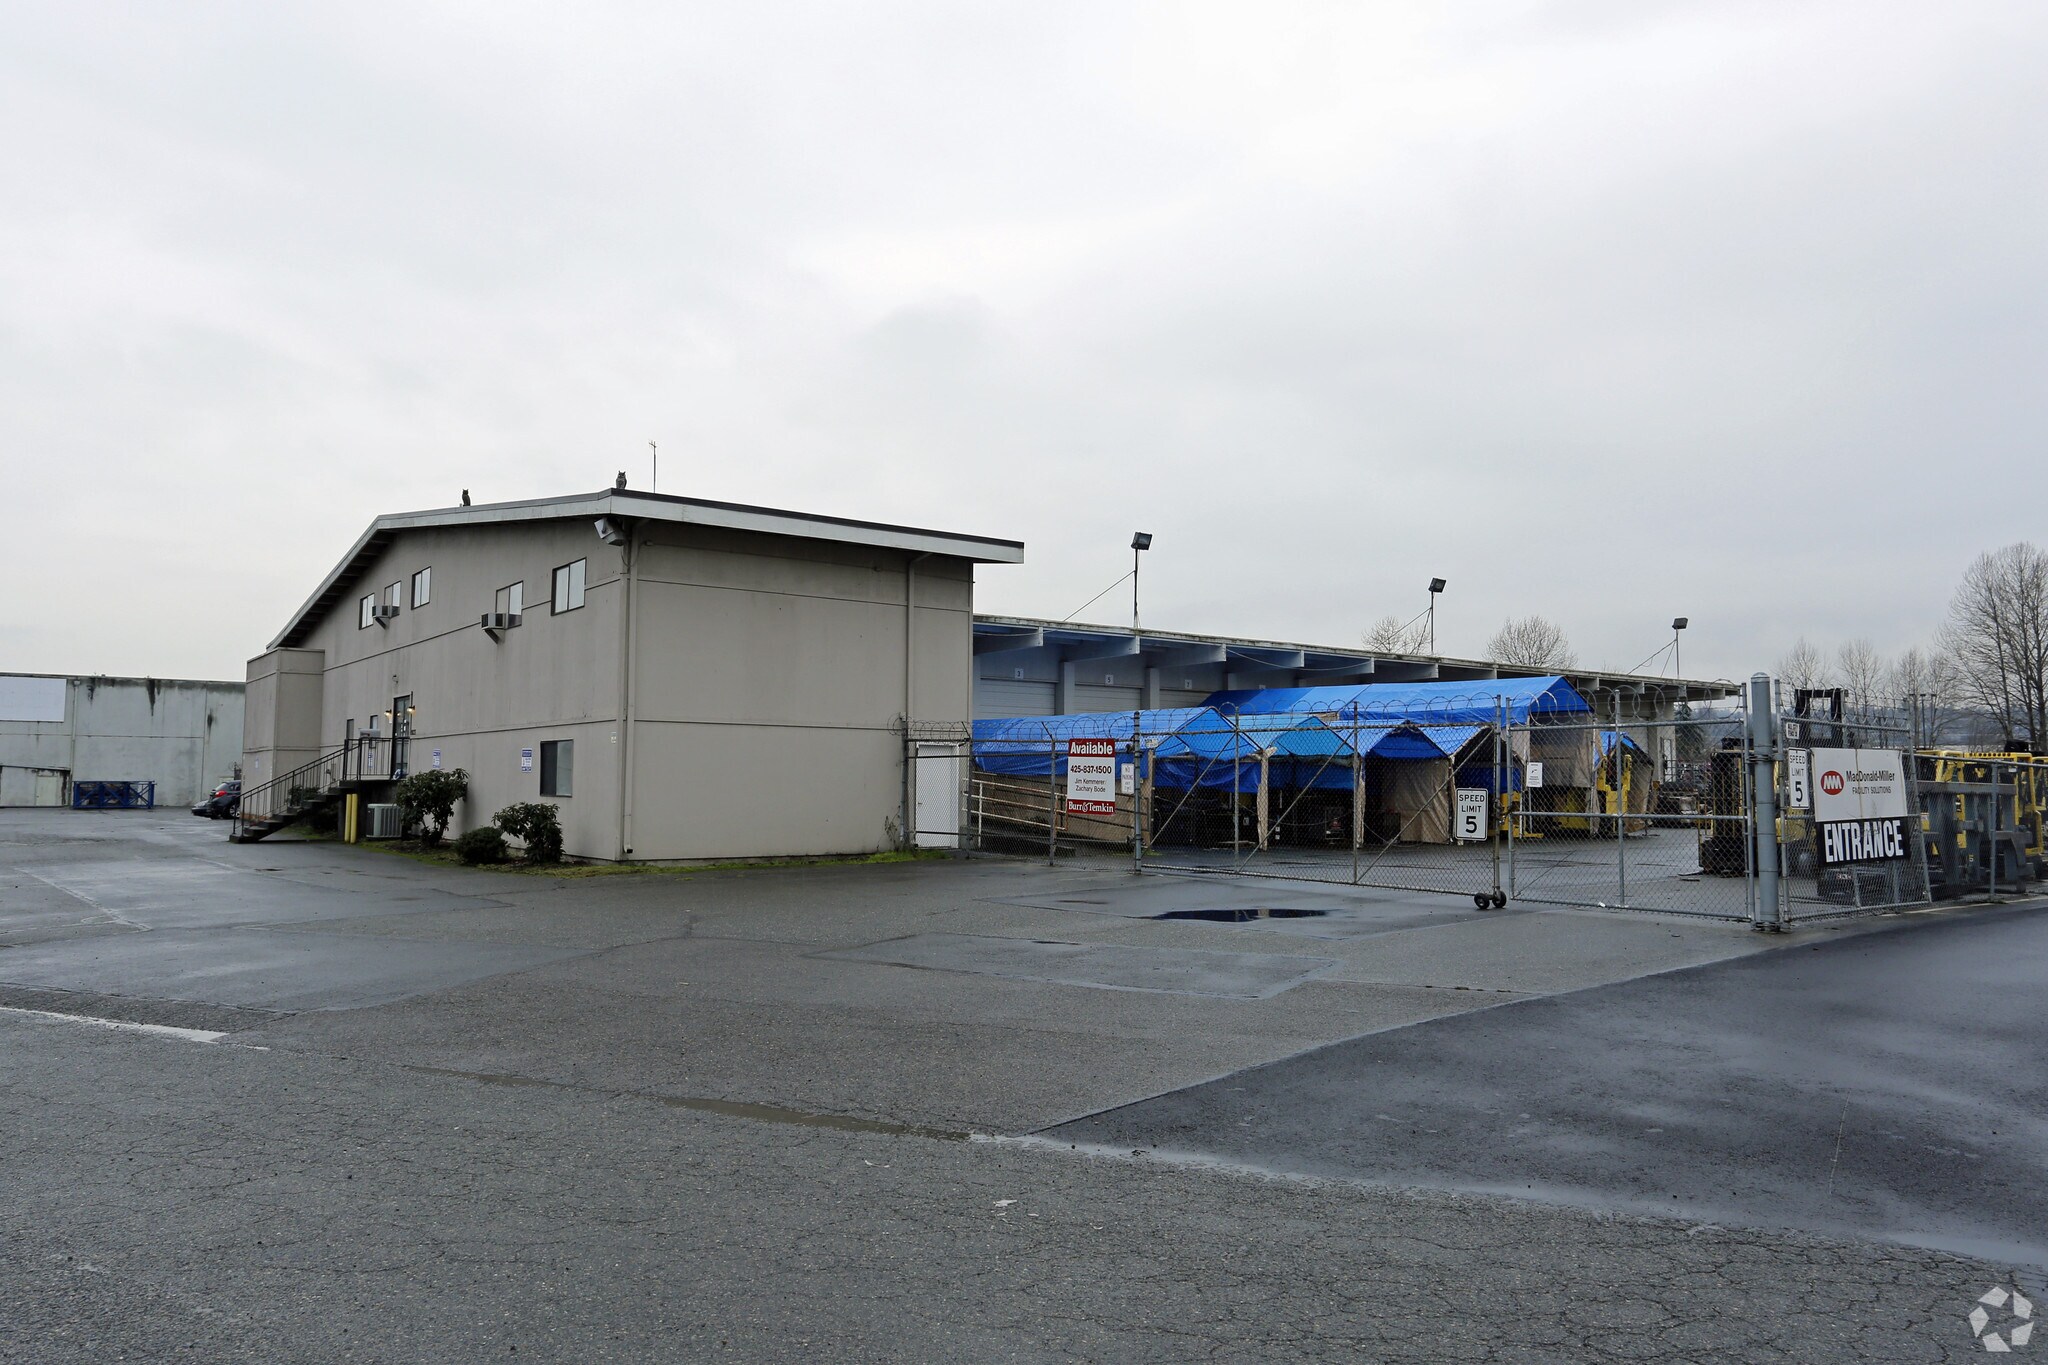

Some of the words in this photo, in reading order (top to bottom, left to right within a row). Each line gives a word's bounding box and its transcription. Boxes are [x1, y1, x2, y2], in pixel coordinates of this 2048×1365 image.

[1070, 741, 1113, 755] Available
[1789, 755, 1806, 765] SPEED
[1791, 768, 1804, 776] LIMIT
[1845, 770, 1895, 782] MacDonald-Miller
[1075, 785, 1094, 793] Zachary
[1094, 785, 1106, 793] Bode
[1795, 780, 1804, 802] 5
[1870, 786, 1892, 794] SOLUTIONS
[1458, 794, 1485, 803] SPEED
[1461, 805, 1482, 813] LIMIT
[1465, 815, 1478, 834] 5
[1823, 819, 1904, 863] ENTRANCE
